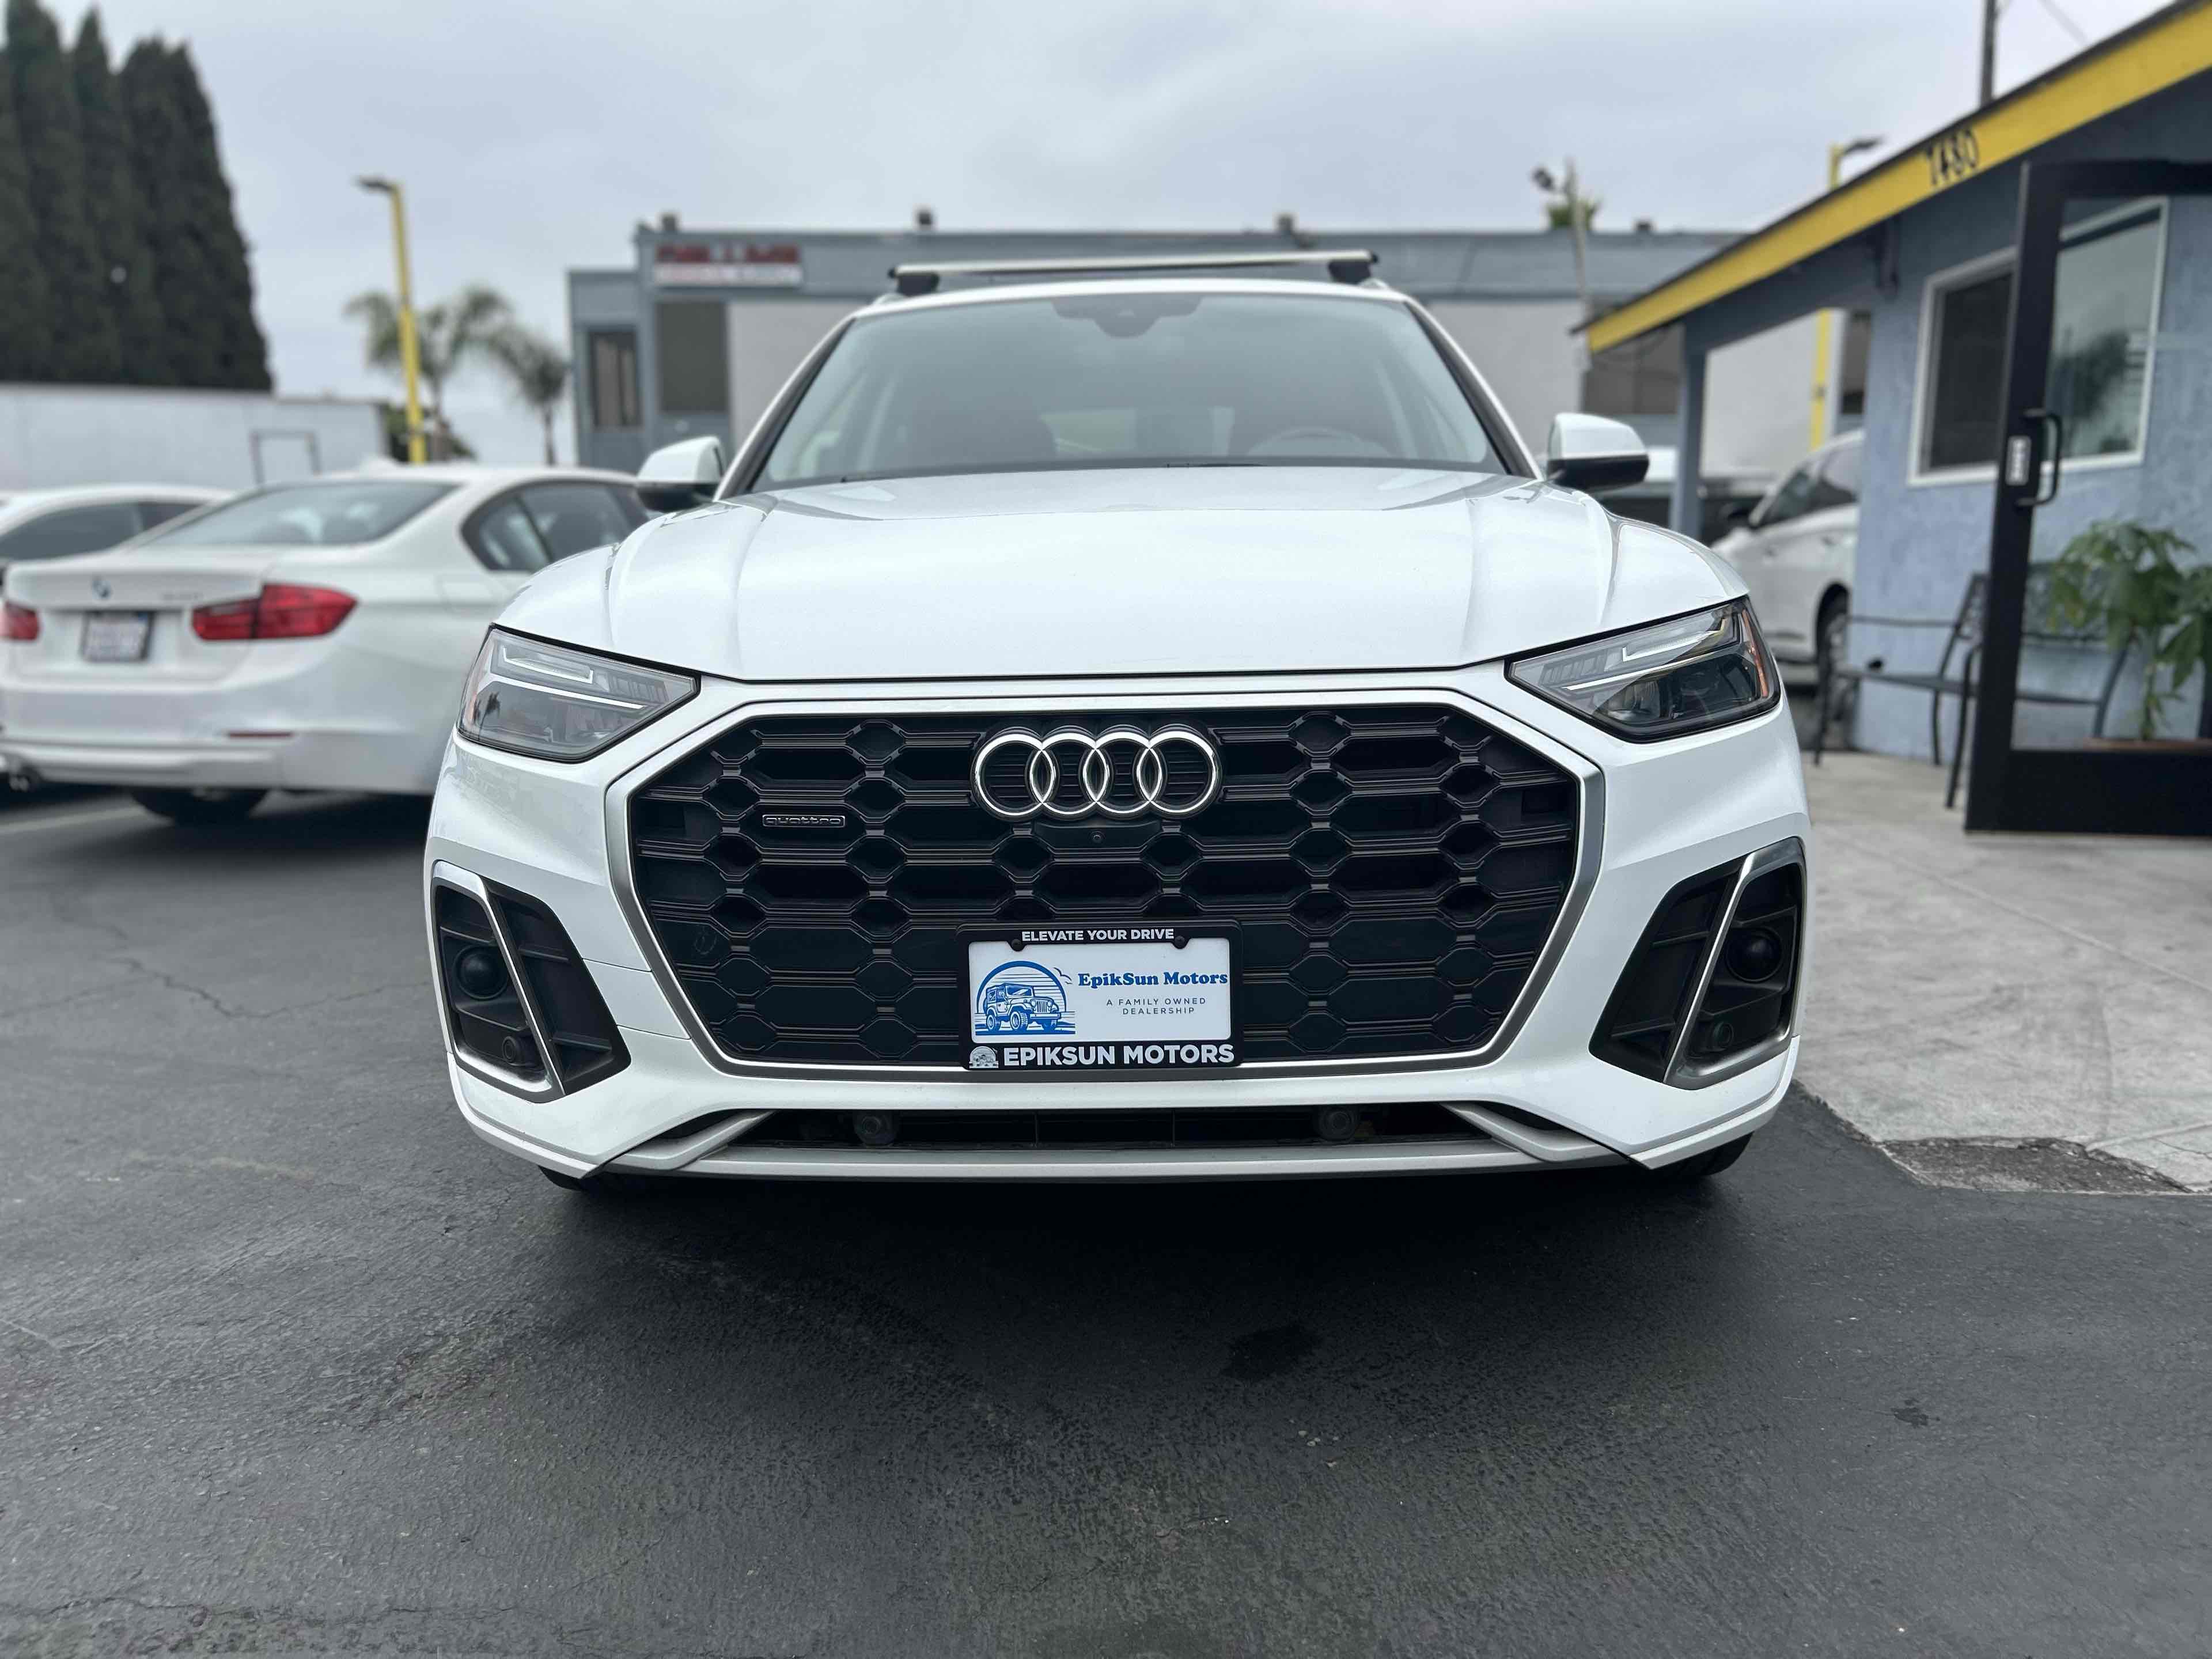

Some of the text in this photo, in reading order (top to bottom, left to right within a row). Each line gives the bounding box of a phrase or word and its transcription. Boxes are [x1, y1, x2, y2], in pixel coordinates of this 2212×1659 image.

[766, 817, 841, 825] quattro
[1022, 929, 1174, 941] ELEVATE YOUR DRIVE
[1078, 972, 1228, 988] EpikSun Motors
[1003, 1044, 1234, 1066] EPIKSUN MOTORS
